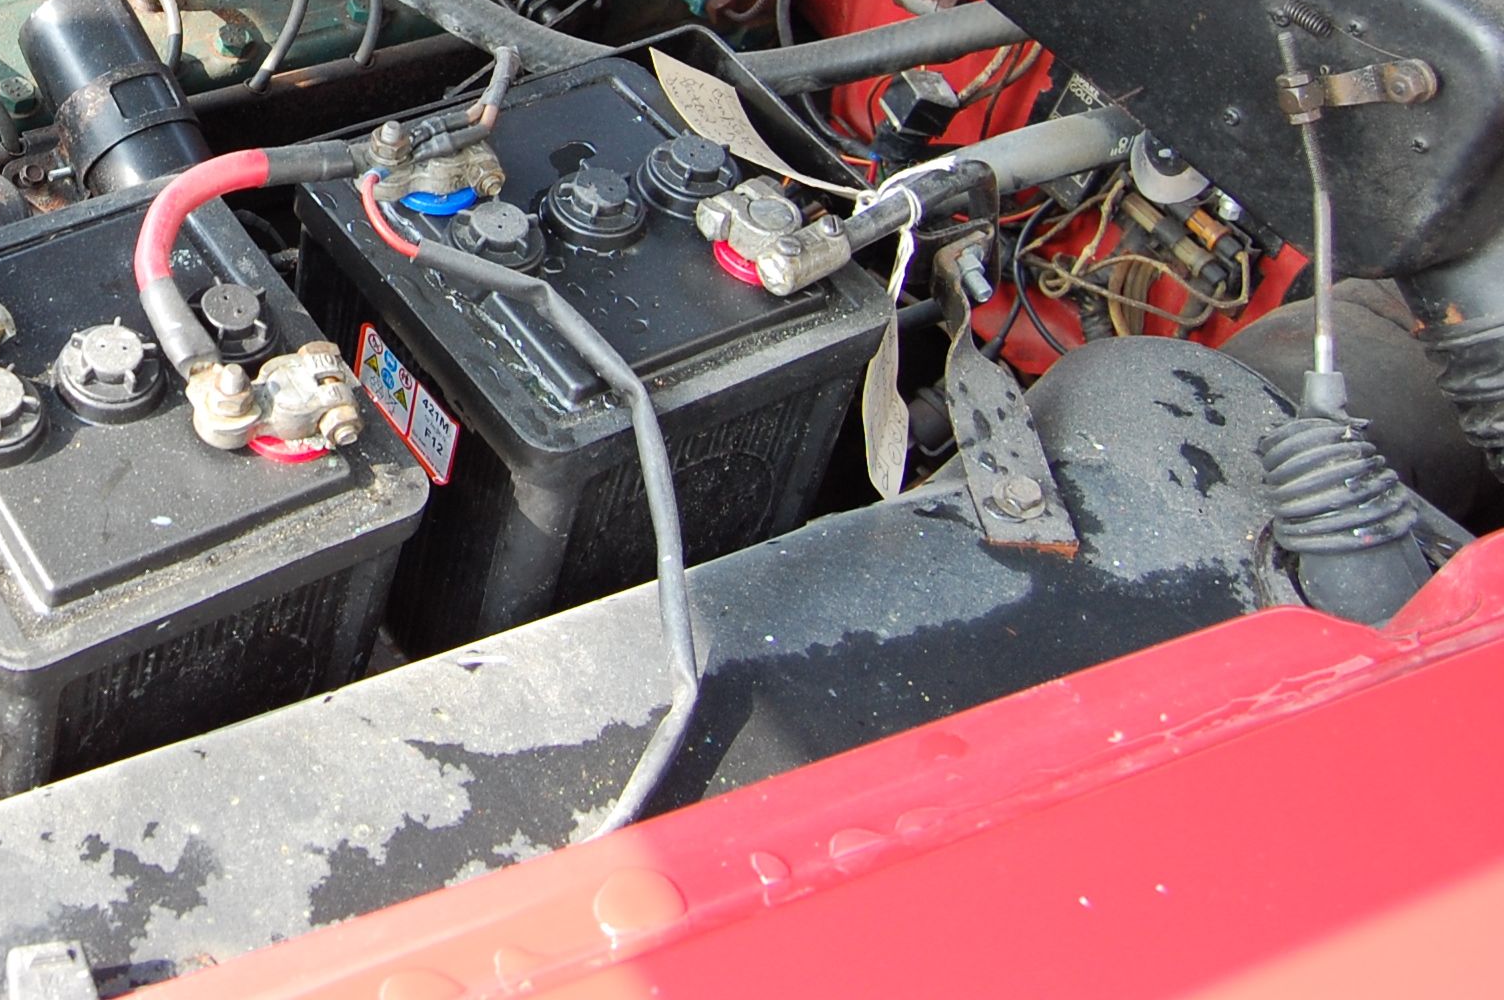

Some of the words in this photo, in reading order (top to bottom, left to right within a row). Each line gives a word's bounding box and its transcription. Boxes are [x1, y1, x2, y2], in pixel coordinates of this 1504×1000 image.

[1070, 83, 1093, 105] GOLD
[422, 399, 450, 434] 421M
[424, 428, 444, 456] F12
